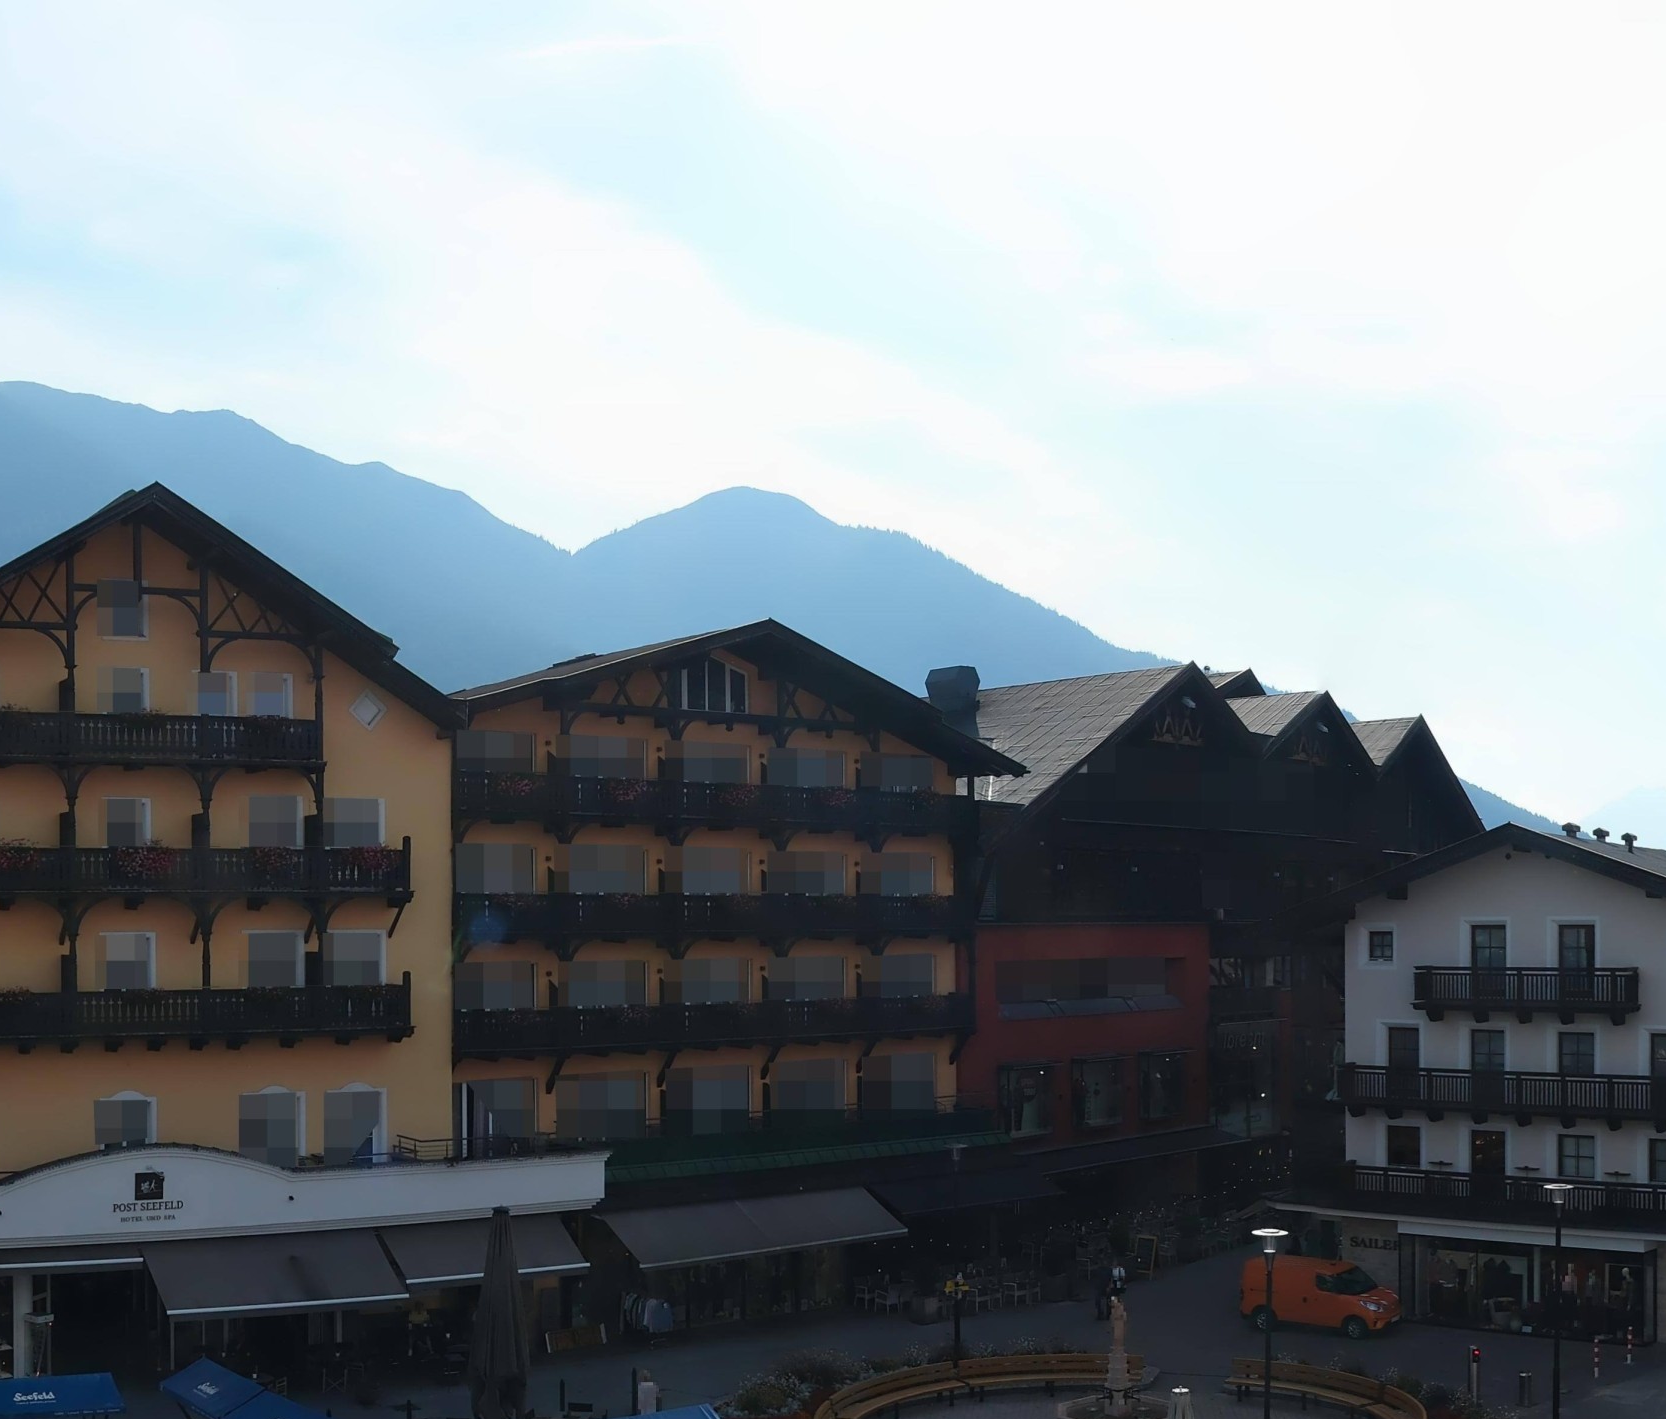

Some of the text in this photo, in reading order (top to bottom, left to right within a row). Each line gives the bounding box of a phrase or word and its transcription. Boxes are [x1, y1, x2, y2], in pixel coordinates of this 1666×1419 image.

[113, 1201, 183, 1212] POST SEEFELD
[13, 1391, 56, 1402] Seefeld
